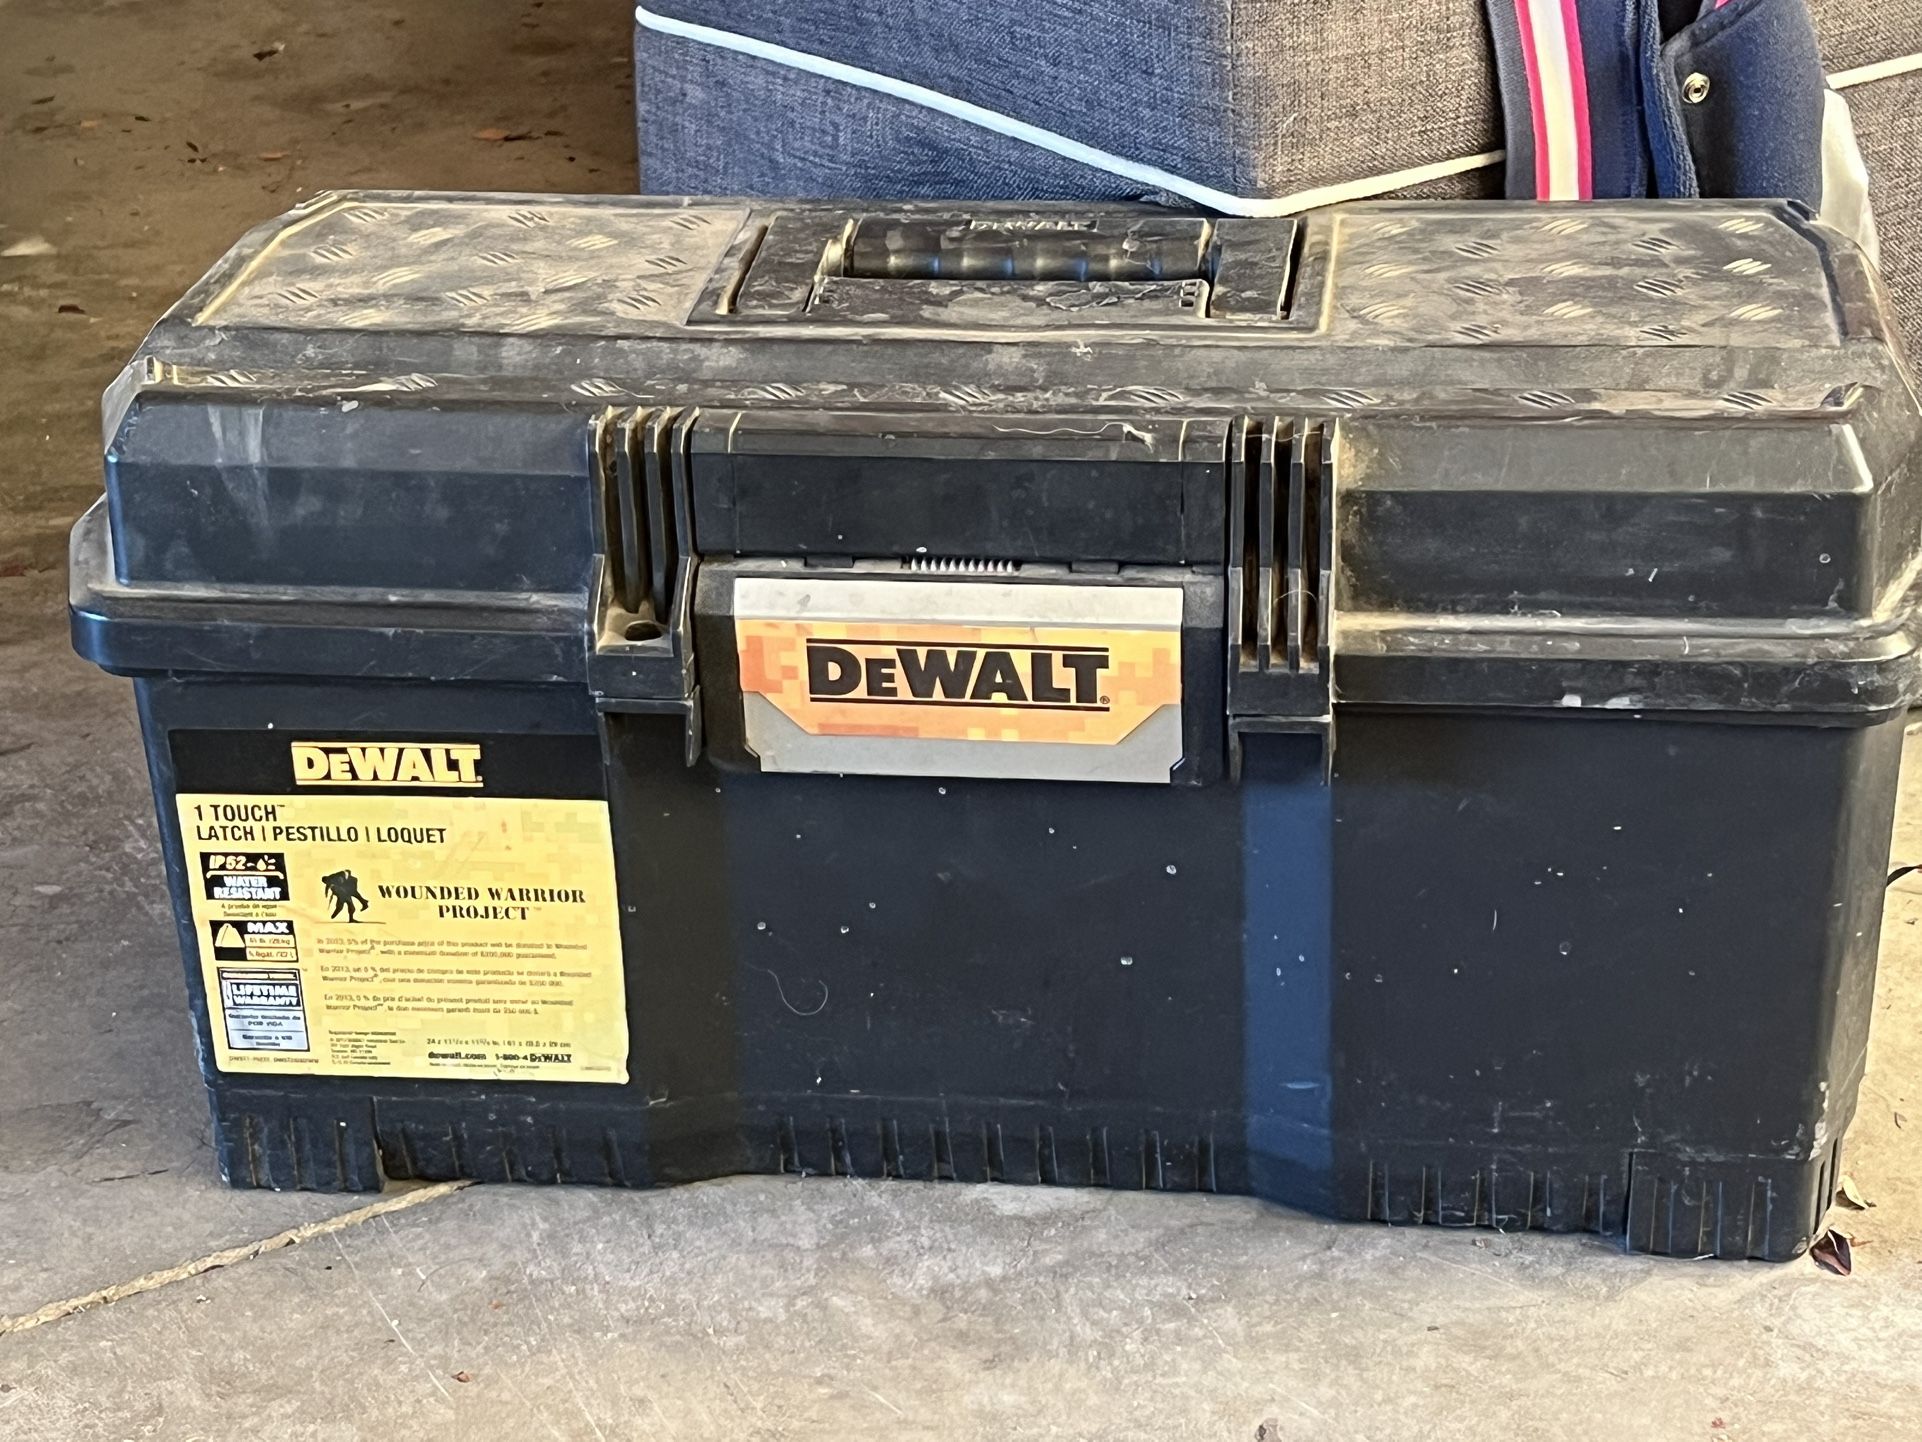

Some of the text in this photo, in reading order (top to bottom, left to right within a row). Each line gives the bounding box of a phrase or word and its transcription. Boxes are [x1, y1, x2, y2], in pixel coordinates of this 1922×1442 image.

[194, 805, 203, 821] 1
[196, 825, 255, 842] LATCH
[273, 826, 359, 843] PESTILLO
[377, 827, 447, 844] LOQUET
[223, 875, 268, 888] WATER
[213, 887, 281, 900] RESISTANT
[378, 884, 586, 904] WOUNDED WARRIOR
[438, 905, 530, 920] PROJECT
[246, 922, 289, 934] MAX
[231, 984, 298, 996] LIFETIME
[233, 995, 299, 1006] WARRANTY
